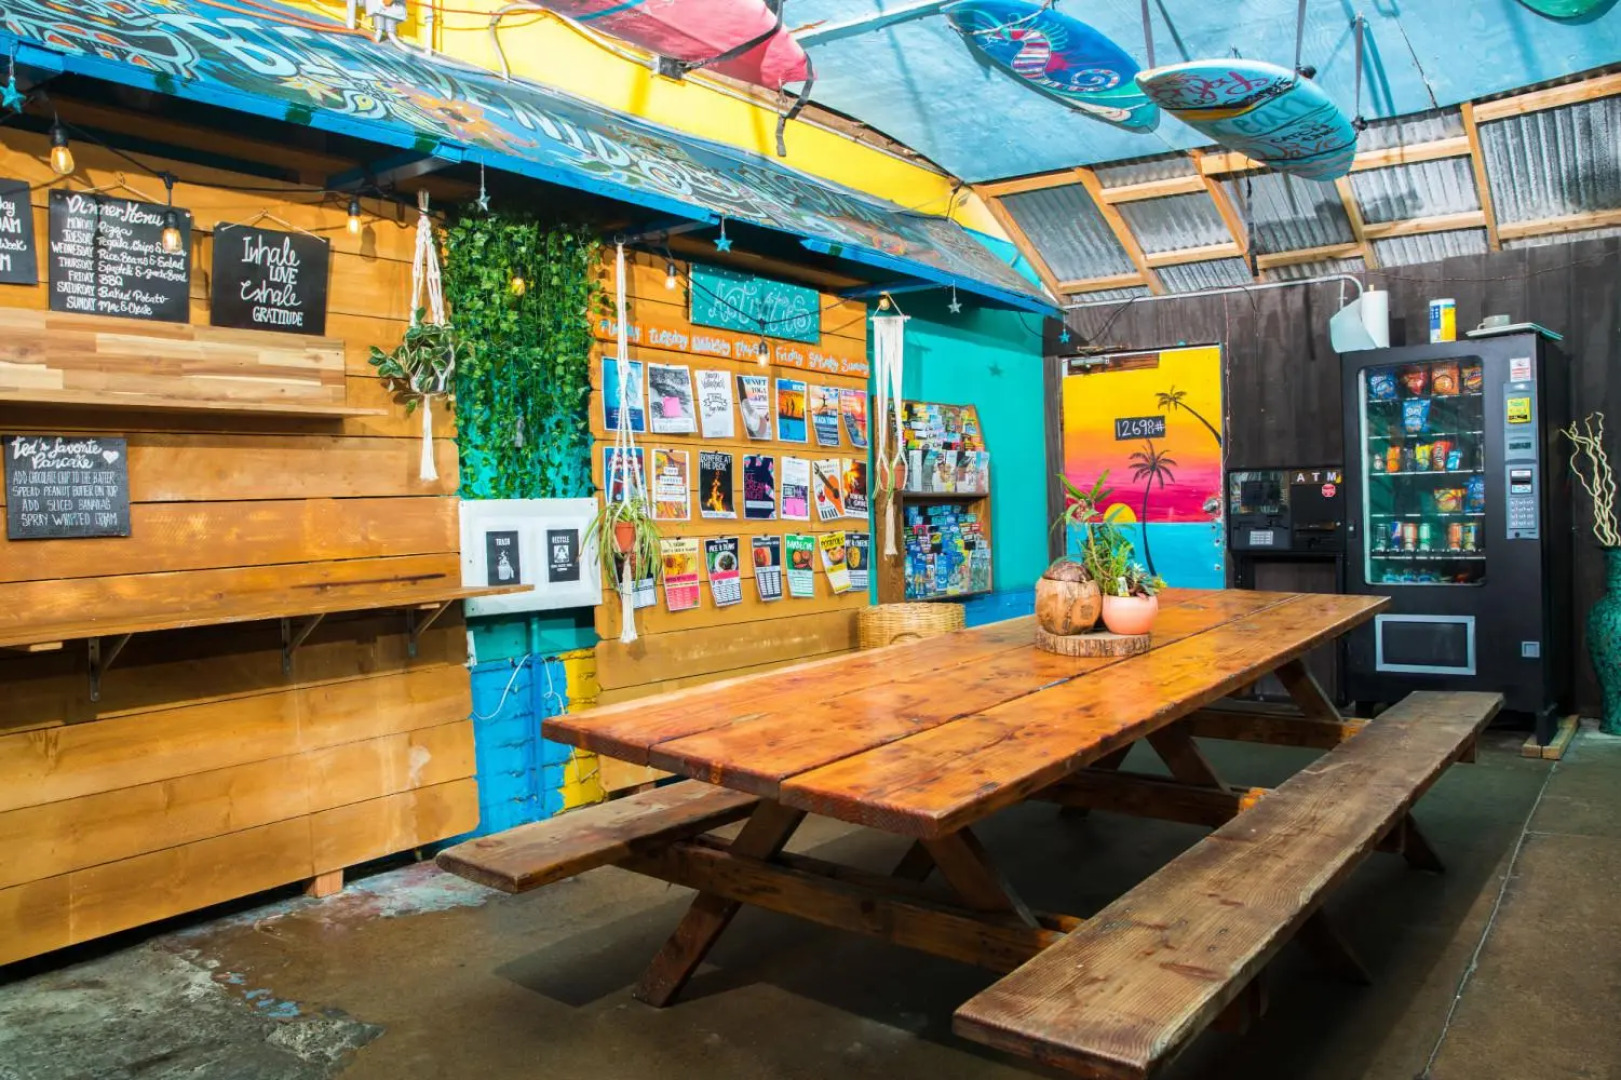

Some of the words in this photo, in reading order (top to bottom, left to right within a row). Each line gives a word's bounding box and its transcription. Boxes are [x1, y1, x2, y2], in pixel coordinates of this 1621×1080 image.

[66, 194, 123, 217] Dinner
[120, 201, 164, 226] Menu
[241, 234, 300, 267] Inhale
[269, 265, 299, 285] LOVE
[240, 279, 302, 307] Exhale
[66, 296, 96, 312] SUNDAY
[252, 306, 304, 326] GRATITUDE
[1116, 420, 1165, 437] 12698#
[701, 461, 713, 470] THE
[714, 463, 727, 471] DECK
[723, 455, 731, 464] AT
[1296, 472, 1337, 483] ATM
[22, 499, 40, 511] ADD
[47, 499, 73, 511] SLICED
[20, 513, 49, 528] SPRAY
